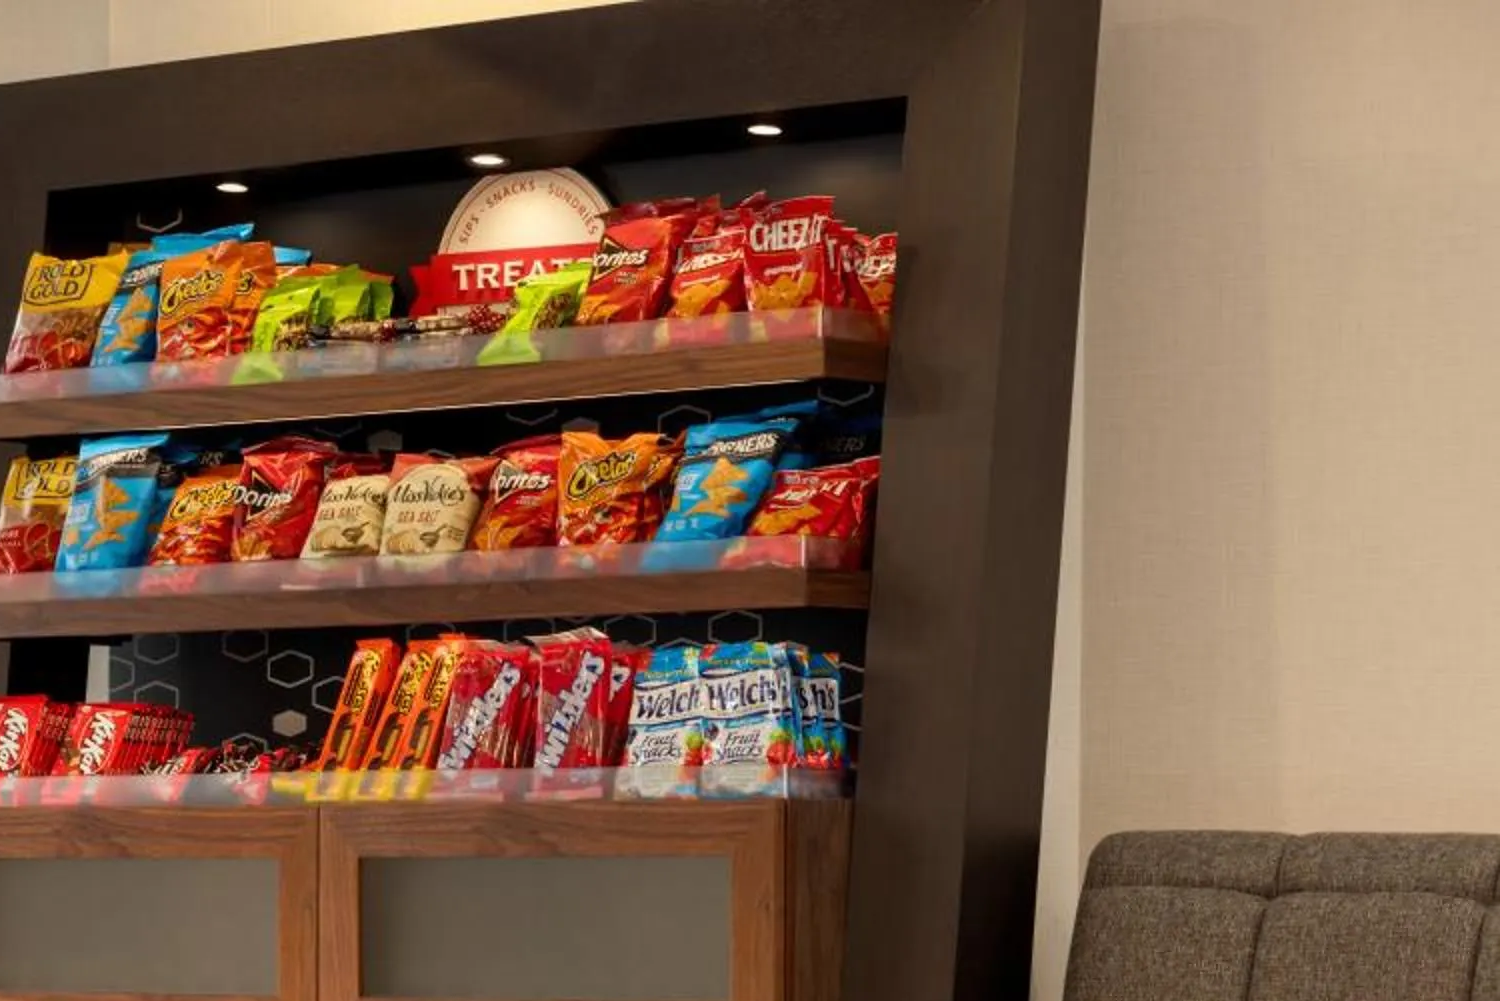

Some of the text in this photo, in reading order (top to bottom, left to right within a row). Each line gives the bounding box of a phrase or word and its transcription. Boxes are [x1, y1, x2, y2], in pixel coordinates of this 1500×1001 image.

[485, 176, 536, 209] SNACKS
[547, 182, 600, 237] SUNDRIES
[451, 257, 593, 291] TREA
[593, 249, 649, 267] oritos
[29, 279, 79, 300] GOLD
[635, 680, 701, 720] Welch
